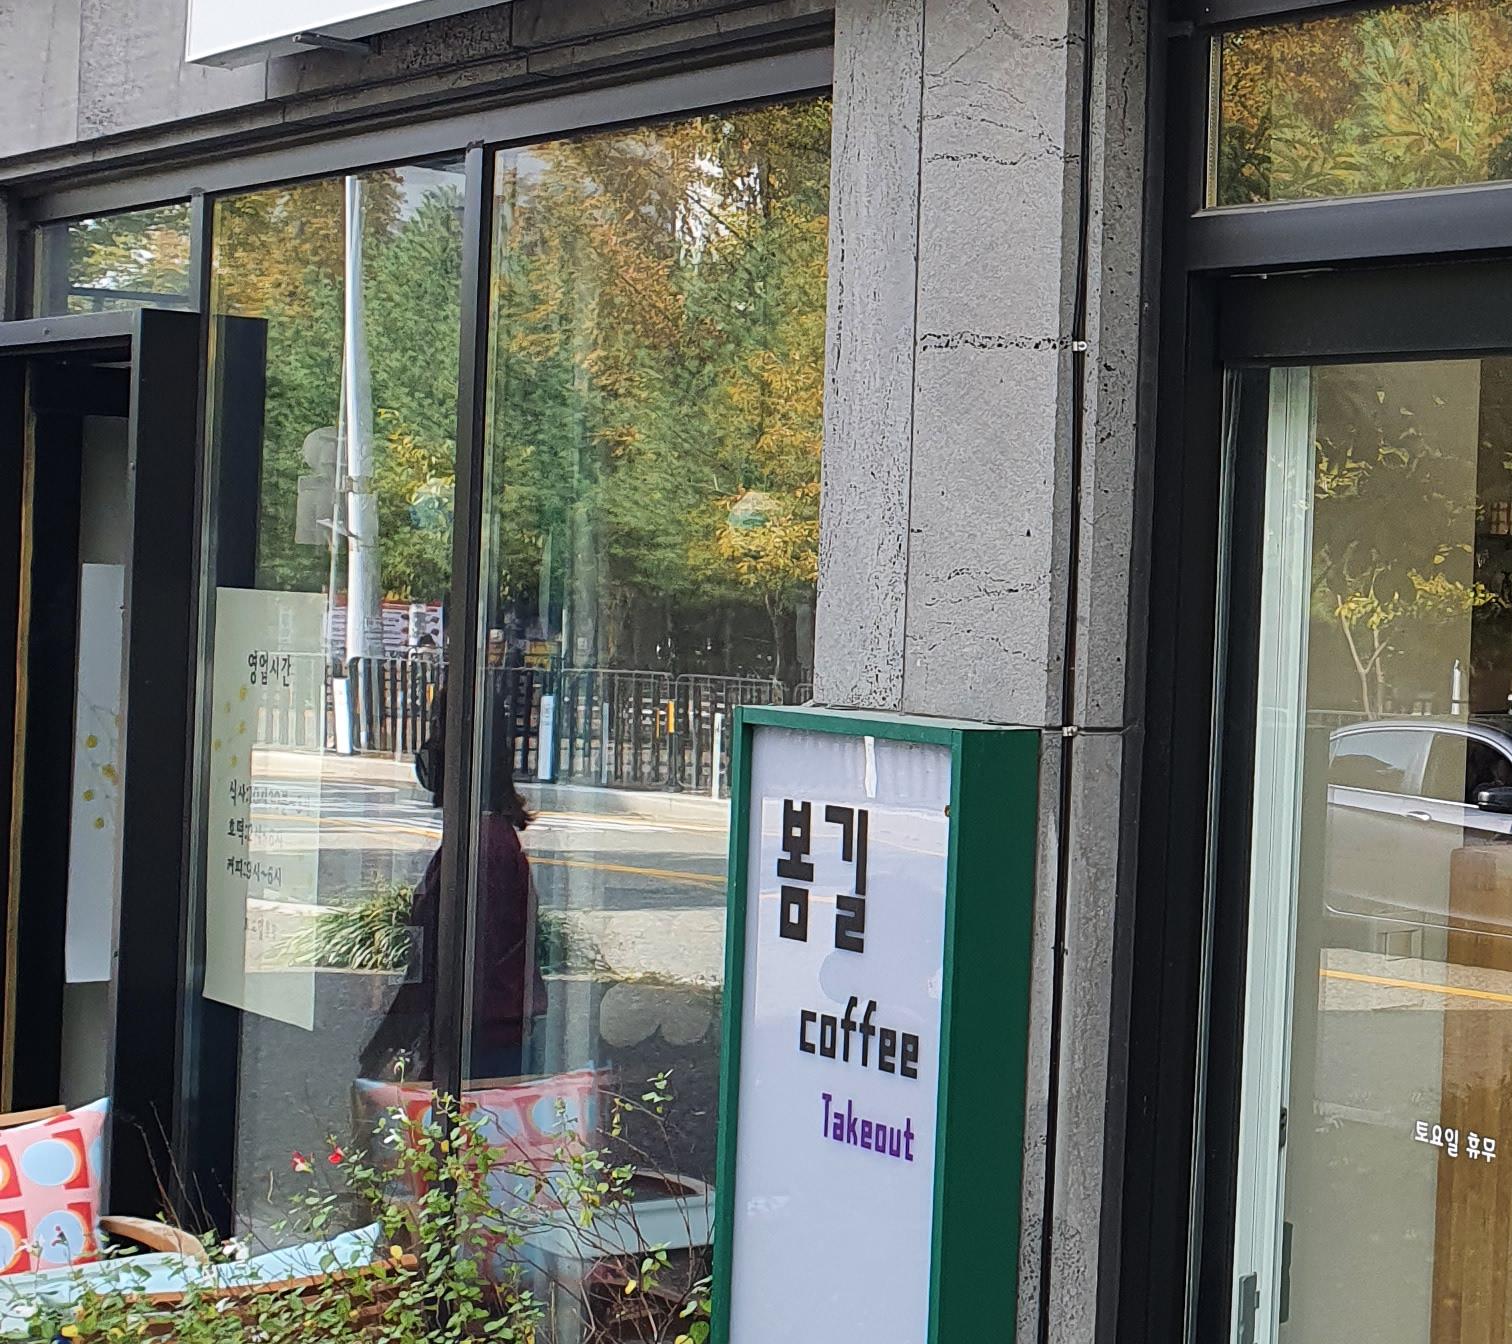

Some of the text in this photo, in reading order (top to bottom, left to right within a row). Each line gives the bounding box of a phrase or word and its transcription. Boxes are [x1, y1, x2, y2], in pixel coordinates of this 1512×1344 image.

[247, 649, 292, 687] 영업시간
[776, 798, 869, 954] 봄길
[799, 995, 919, 1080] coffee
[821, 1092, 915, 1162] Takeout
[1414, 1120, 1497, 1163] 토요일 휴무
